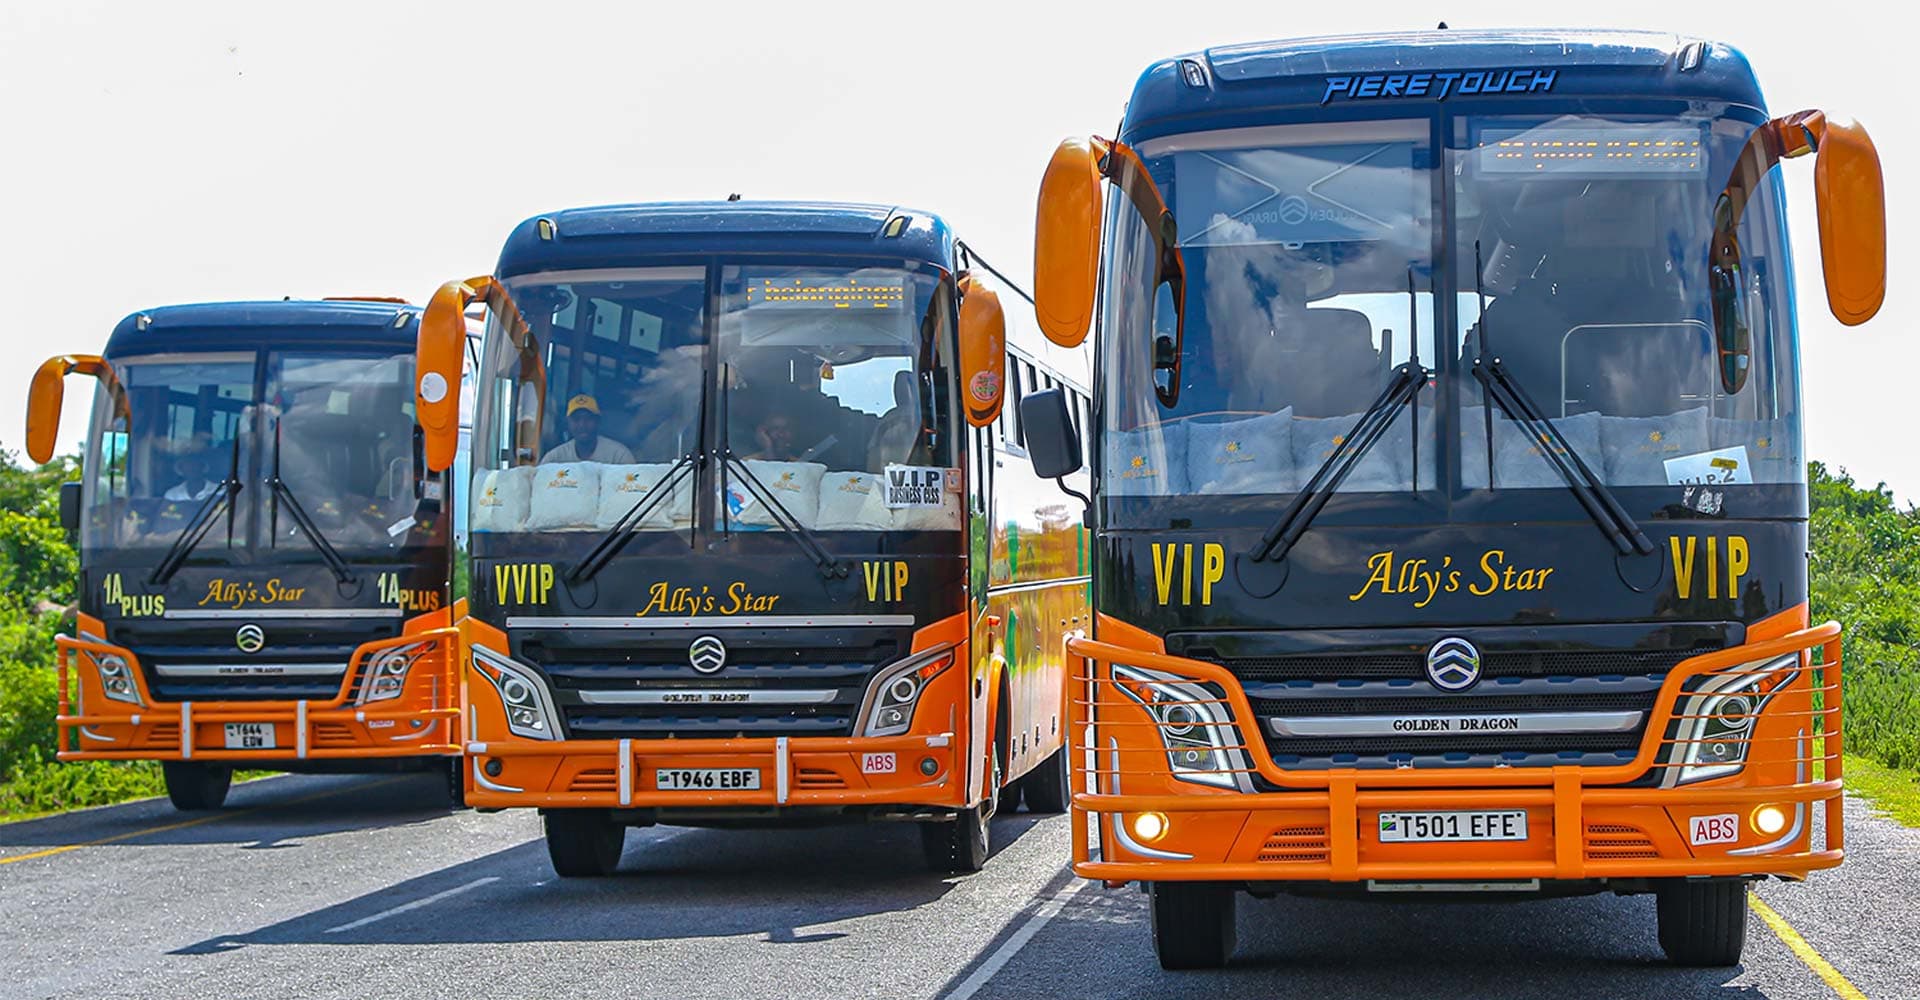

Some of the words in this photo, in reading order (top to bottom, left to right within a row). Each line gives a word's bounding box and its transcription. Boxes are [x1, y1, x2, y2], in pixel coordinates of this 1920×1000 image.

[889, 470, 941, 487] V.I.P
[863, 561, 910, 602] VIP
[1152, 542, 1225, 605] VIP
[1349, 550, 1461, 609] Ally's
[1468, 550, 1555, 597] Star
[1669, 535, 1749, 599] VIP
[103, 572, 123, 605] 1A
[121, 594, 166, 617] PLUS
[198, 578, 257, 609] Ally's
[260, 578, 305, 604] Star
[378, 572, 400, 603] 1A
[399, 589, 440, 610] PLUS
[495, 563, 554, 605] VVIP
[636, 581, 714, 617] Ally's
[719, 581, 780, 614] Star
[236, 724, 262, 735] T644
[1393, 719, 1450, 732] GOLDEN
[1460, 718, 1519, 731] DRAGON
[670, 769, 713, 788] T946
[720, 769, 753, 787] EBF
[865, 754, 894, 771] ABS
[1400, 815, 1460, 838] T501
[1471, 814, 1516, 837] EFE
[1695, 818, 1735, 842] ABS
